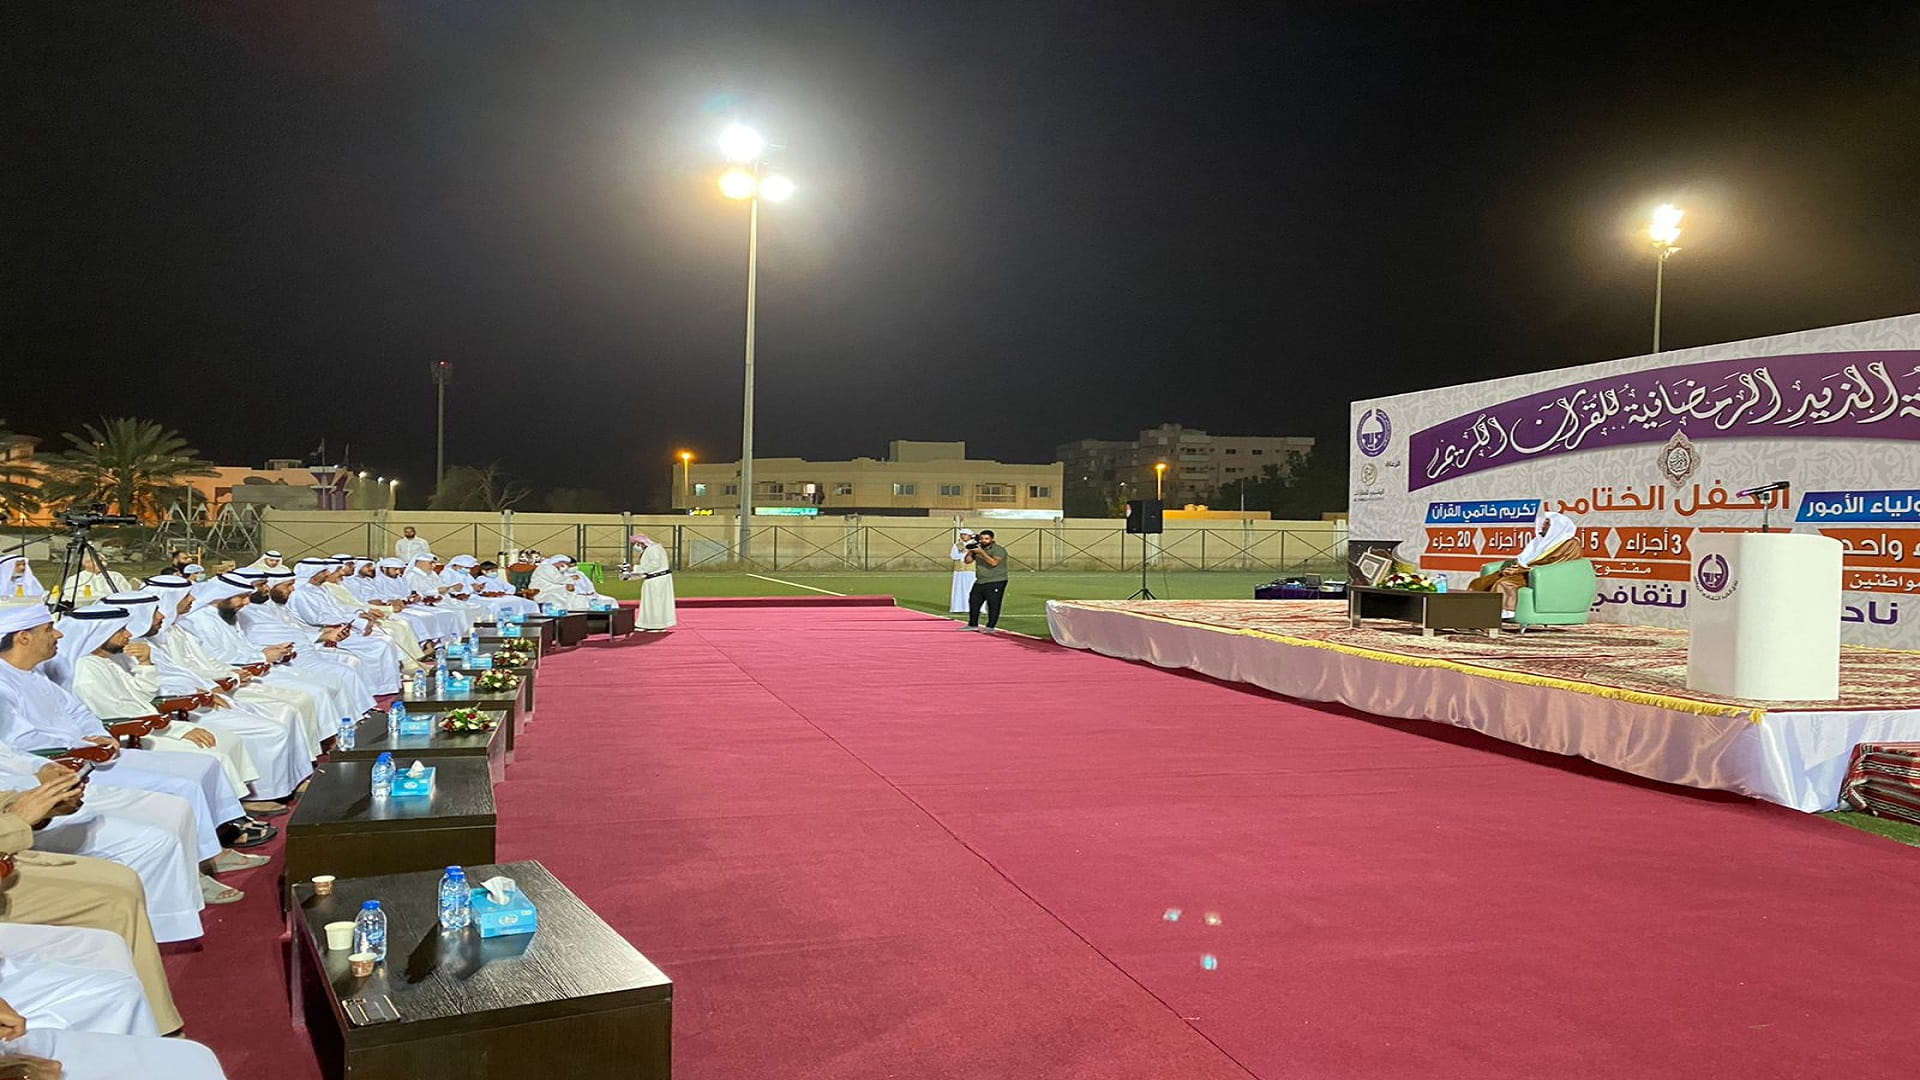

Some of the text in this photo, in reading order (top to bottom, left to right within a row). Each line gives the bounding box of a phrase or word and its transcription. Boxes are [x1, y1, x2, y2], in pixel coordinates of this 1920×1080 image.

[1624, 367, 1782, 430] الرمضانية
[1426, 412, 1508, 479] الكريم
[1674, 479, 1790, 517] الحفل
[1806, 493, 1864, 517] الأمور
[1431, 503, 1537, 523] تكريم خاتمي القرآن
[1432, 531, 1471, 551] 20 جزء
[1488, 529, 1532, 551] 10 أجزاء
[1590, 532, 1600, 550] 5
[1626, 528, 1682, 554] 3 أجزاء
[1594, 562, 1652, 577] مفتوح
[1590, 583, 1687, 612] لثقافي
